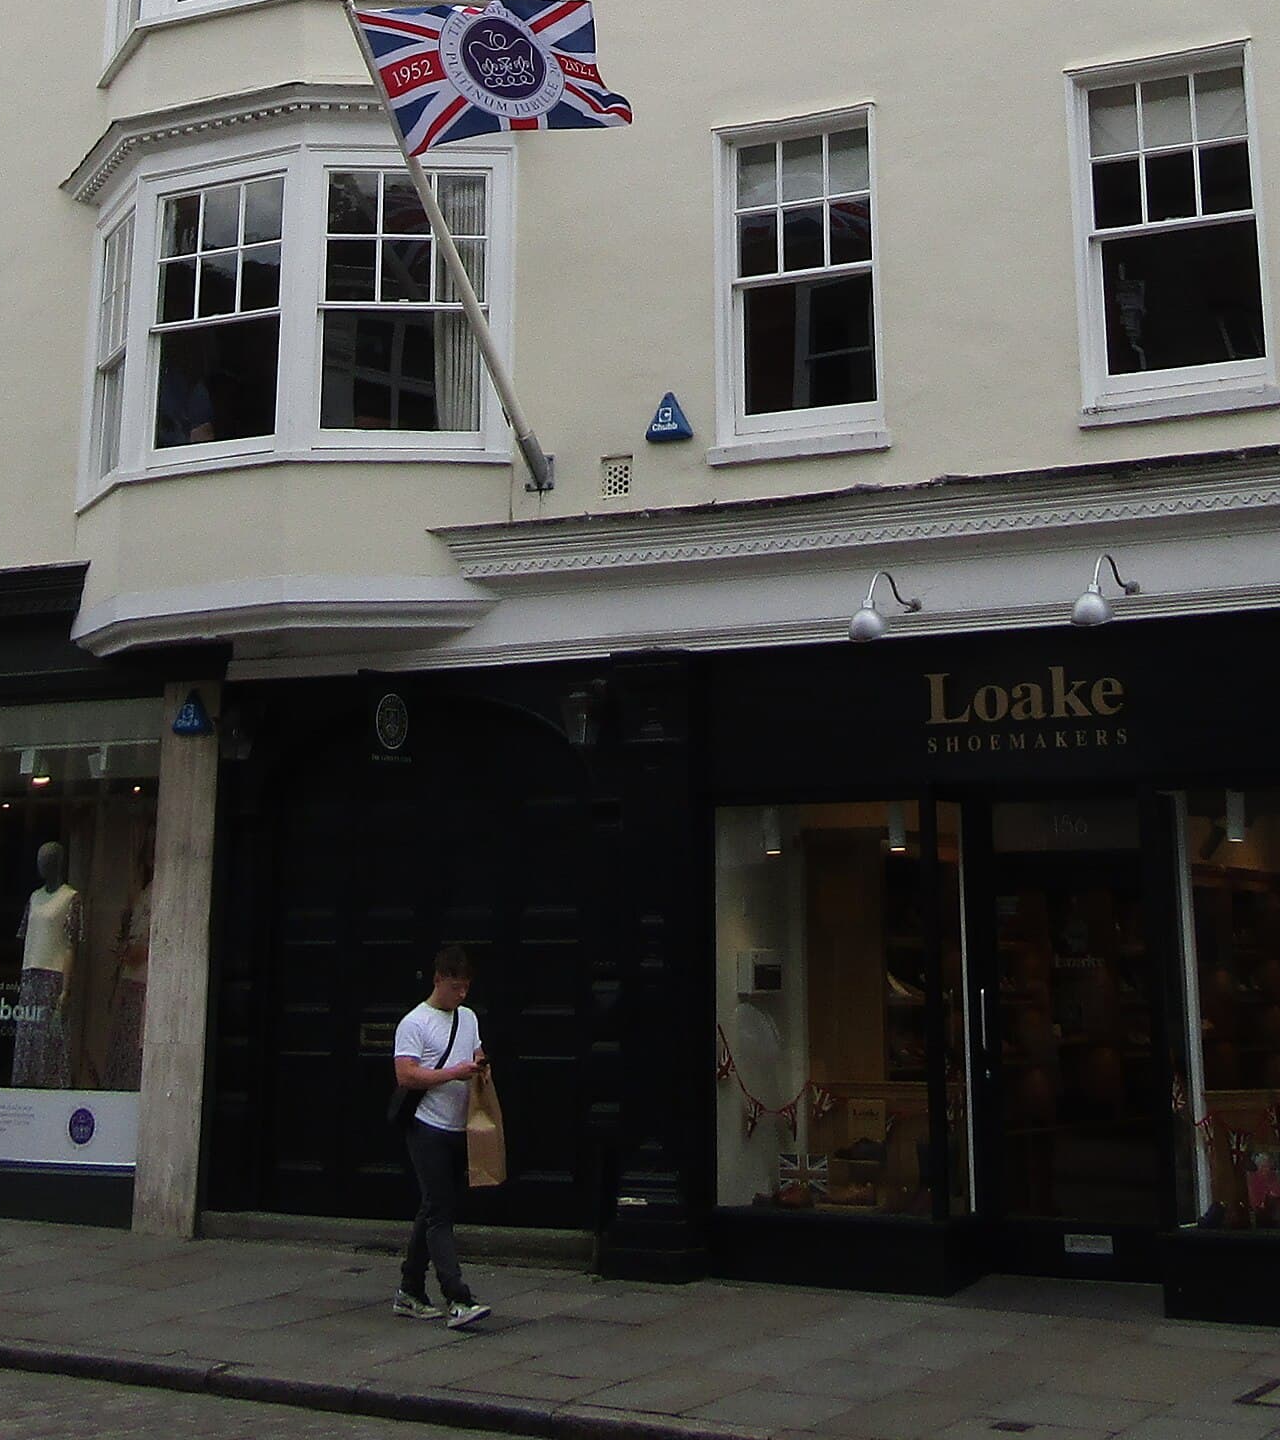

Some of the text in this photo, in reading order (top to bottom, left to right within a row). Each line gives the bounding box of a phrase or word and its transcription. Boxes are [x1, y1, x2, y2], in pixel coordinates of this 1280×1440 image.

[391, 59, 433, 88] 1952
[445, 51, 508, 112] PLATINUM
[515, 81, 559, 115] JUBILEE
[923, 665, 1125, 725] Loake
[926, 727, 1128, 754] SHOEMAKERS
